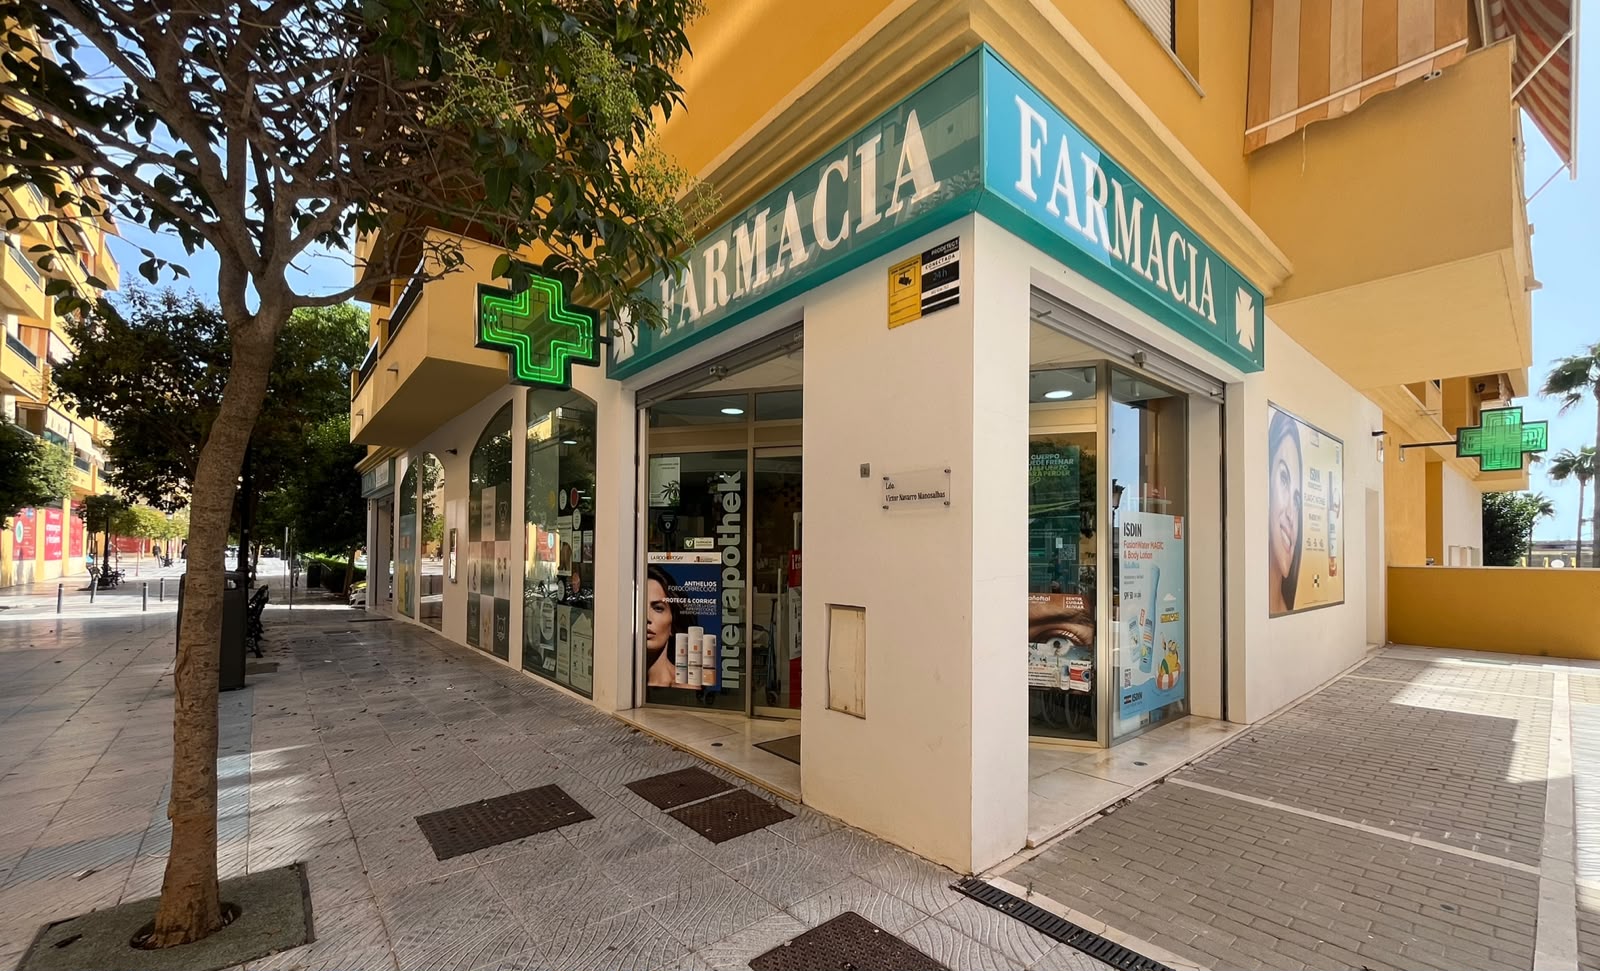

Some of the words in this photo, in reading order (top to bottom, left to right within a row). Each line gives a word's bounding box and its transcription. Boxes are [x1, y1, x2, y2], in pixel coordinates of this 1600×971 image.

[658, 109, 942, 339] FARMACIA
[925, 253, 956, 270] CONECTADA
[1015, 94, 1217, 325] FARMACIA
[716, 471, 744, 689] interapothek
[1123, 522, 1142, 537] ISDIN
[1127, 550, 1139, 560] Body
[1139, 551, 1153, 560] Lotion
